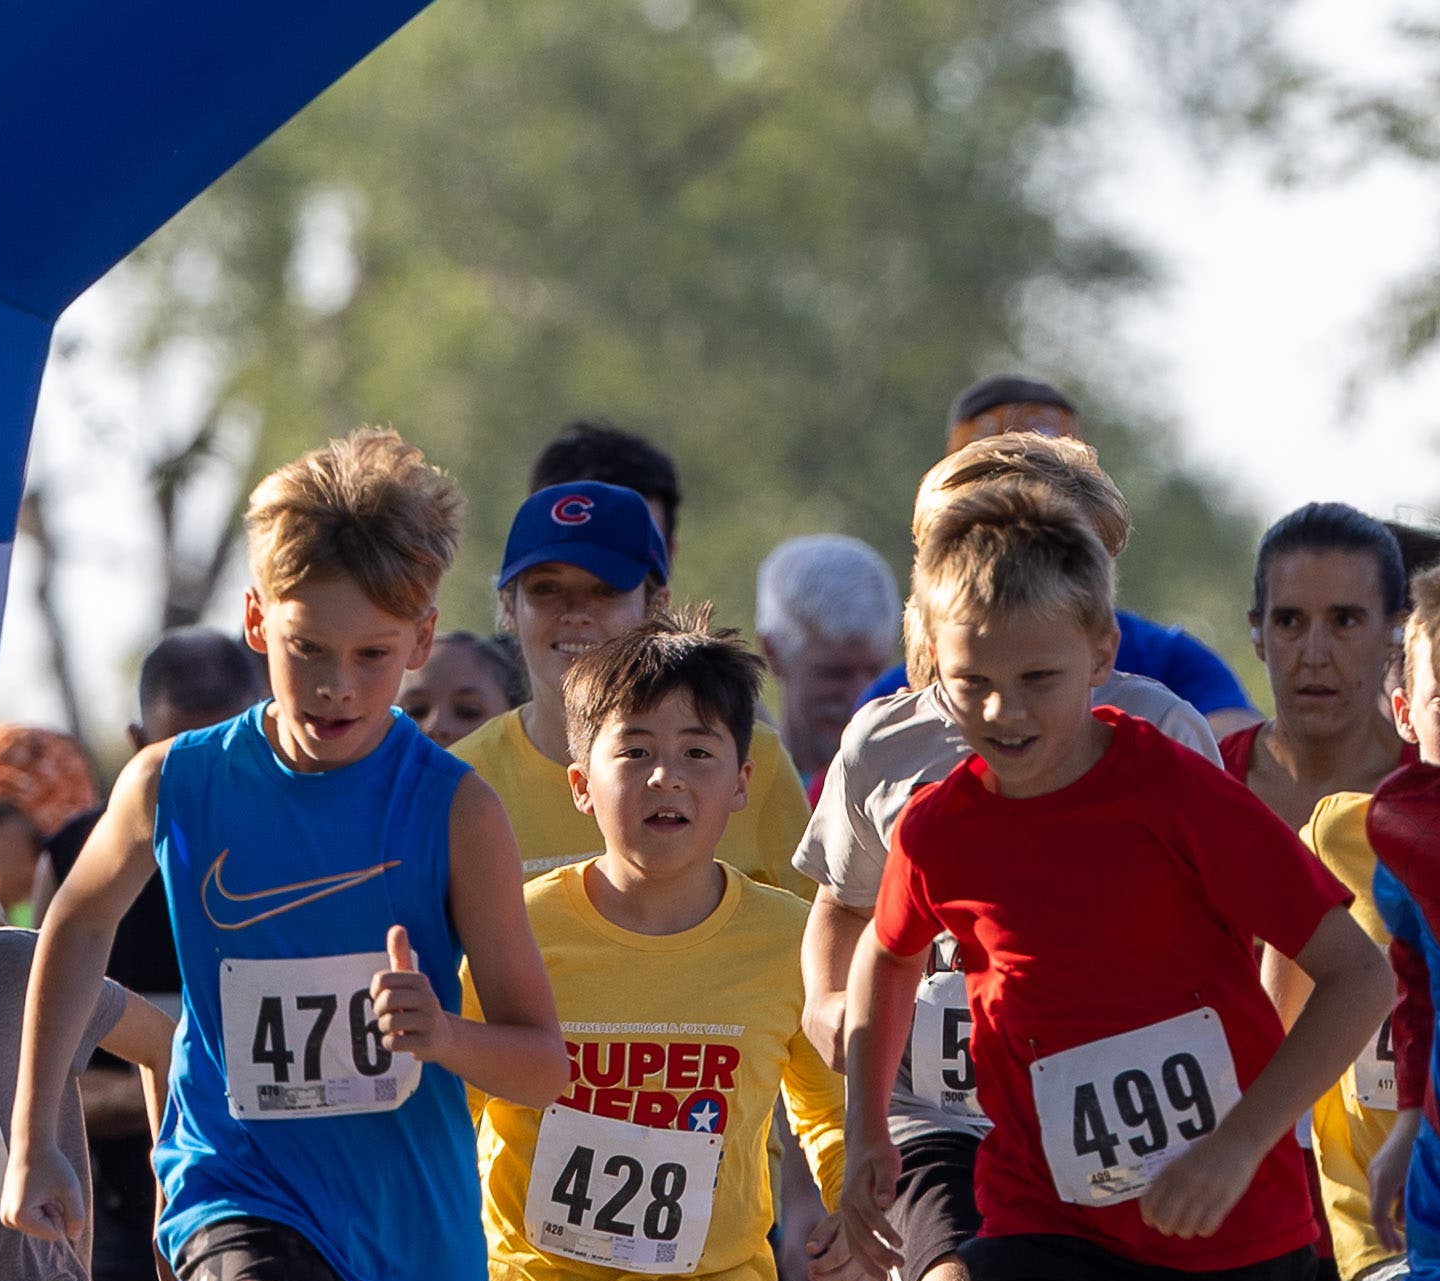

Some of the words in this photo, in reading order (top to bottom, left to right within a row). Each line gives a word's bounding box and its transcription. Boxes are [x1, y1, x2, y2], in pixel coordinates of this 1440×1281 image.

[252, 988, 393, 1083] 476
[1073, 1052, 1217, 1169] 499
[545, 1222, 564, 1236] 428
[551, 1145, 688, 1241] 428
